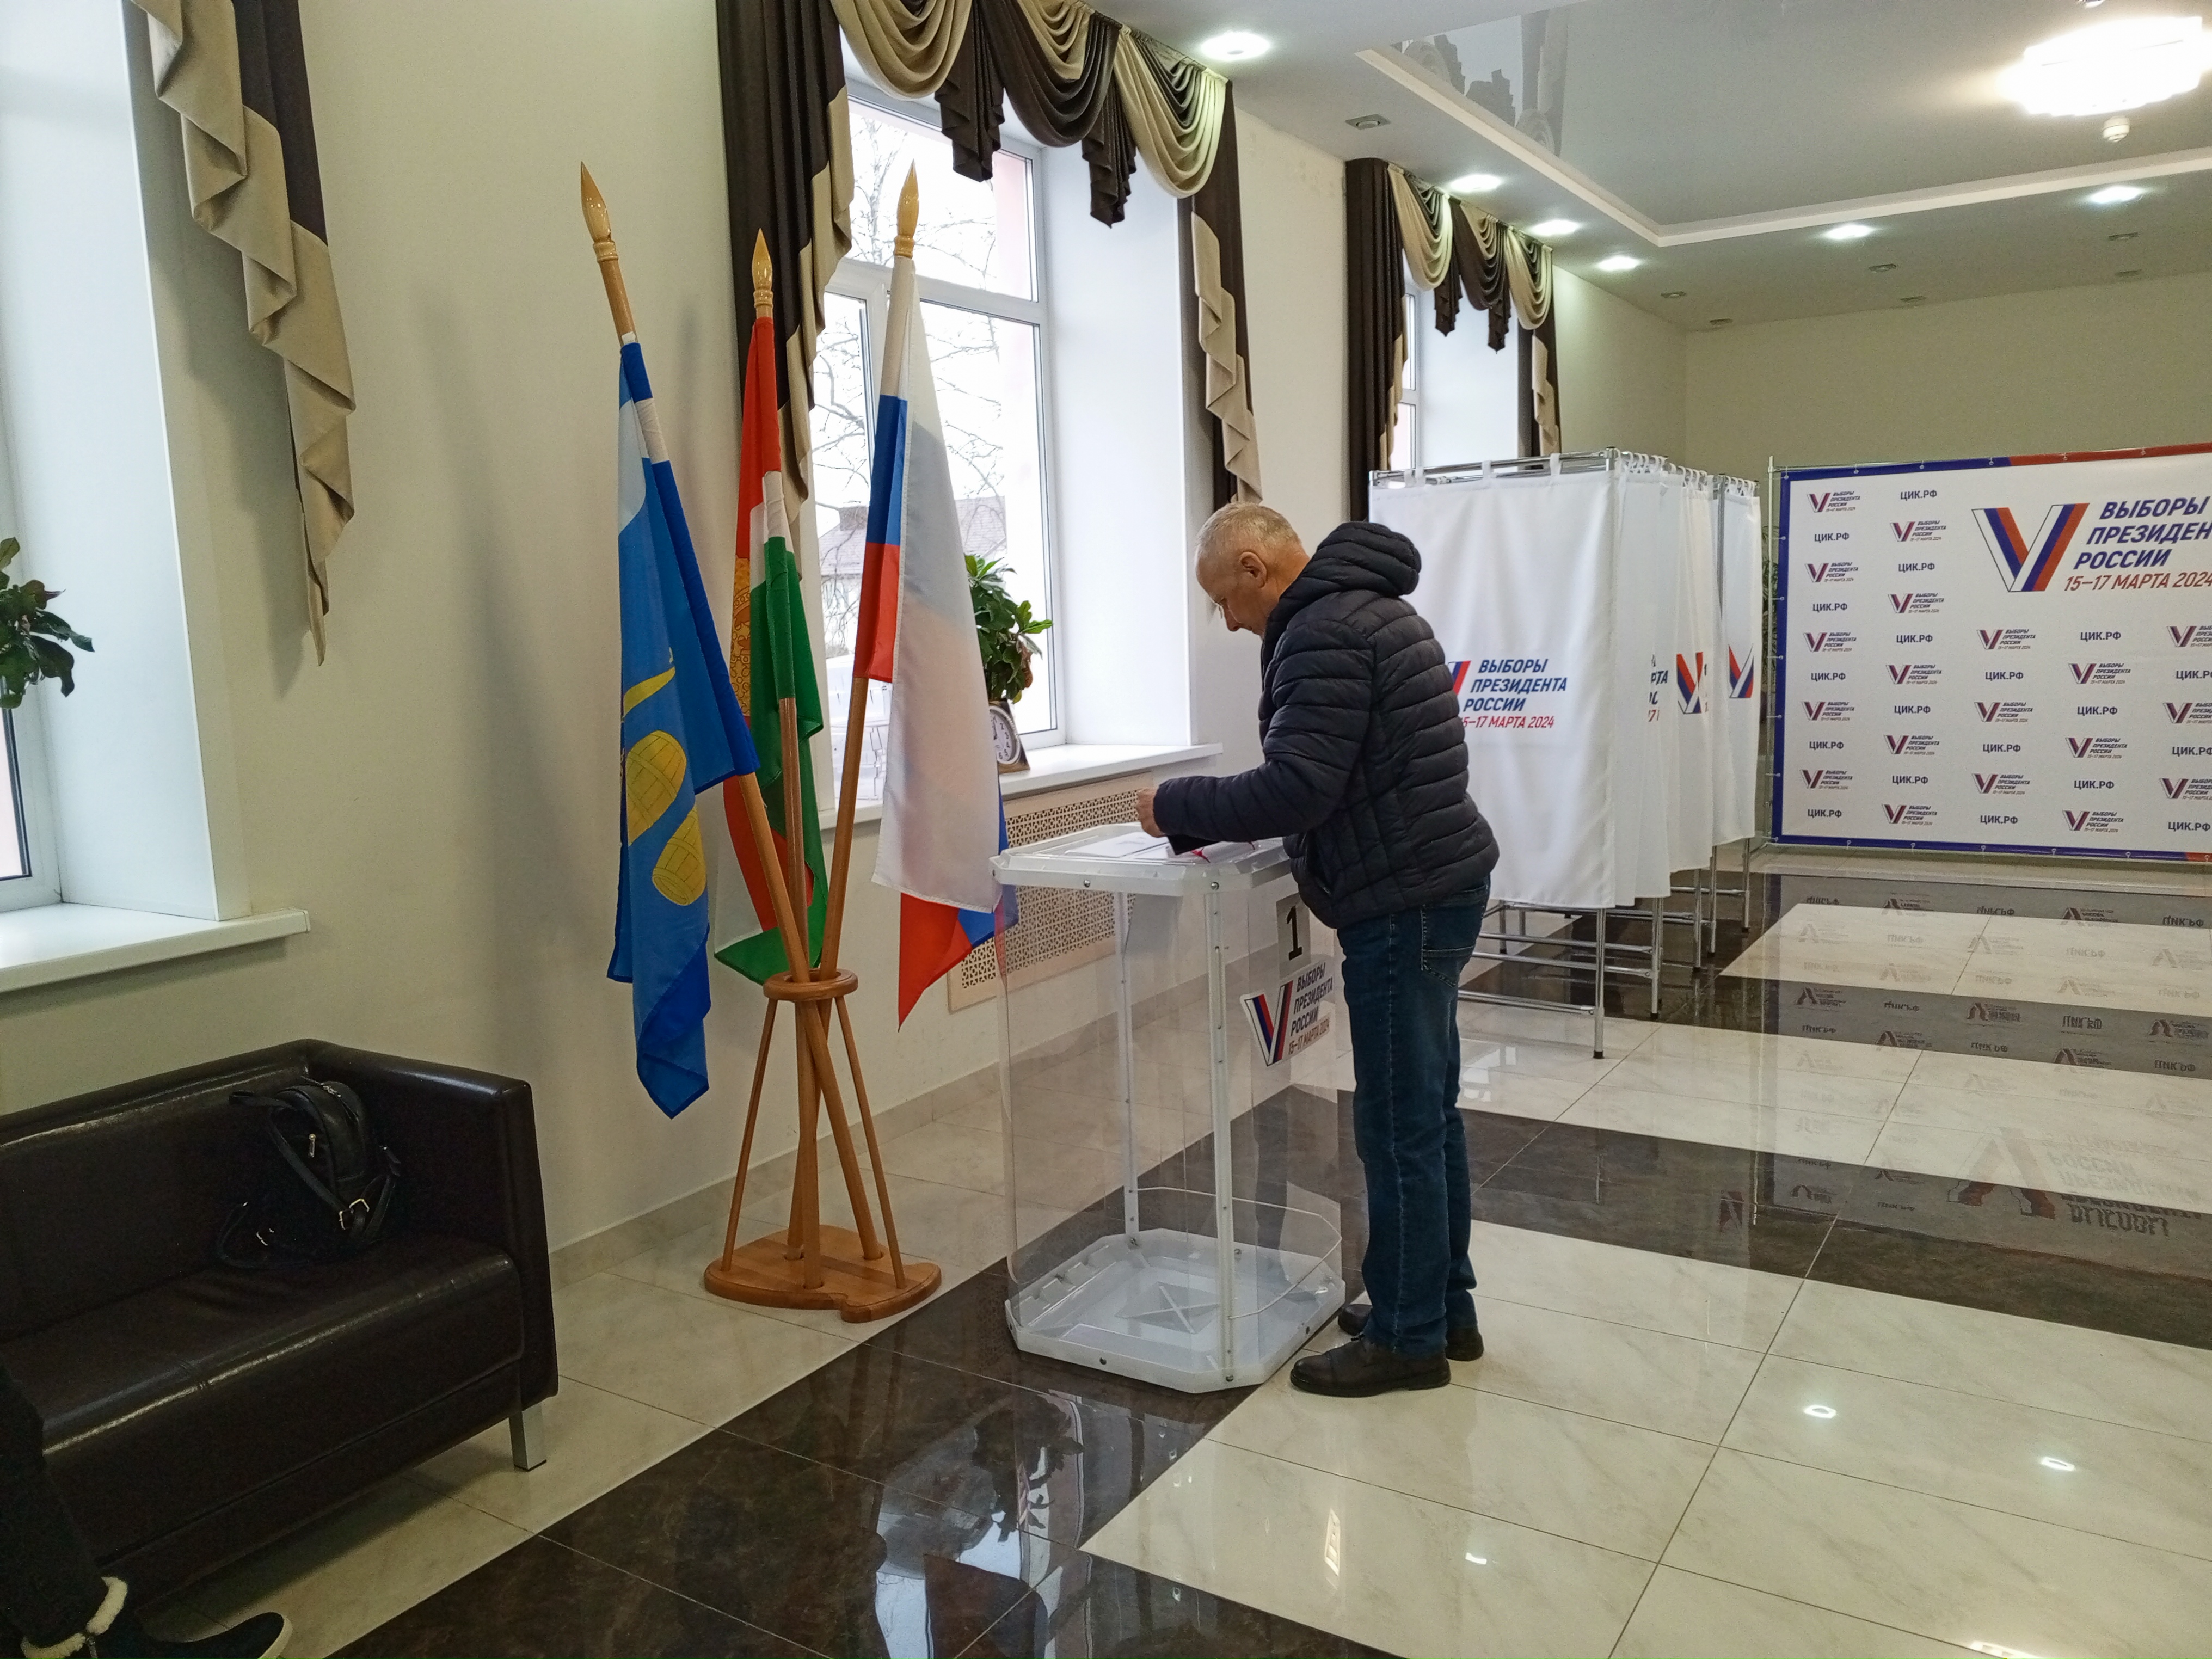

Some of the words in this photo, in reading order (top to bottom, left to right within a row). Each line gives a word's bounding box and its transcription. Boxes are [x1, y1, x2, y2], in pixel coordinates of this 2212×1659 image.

[1901, 490, 1937, 501] ЦИК.РФ
[2099, 496, 2210, 520] ВЫБОРЫ
[1815, 532, 1849, 543] ЦИК.РФ
[2073, 549, 2173, 570] РОССИИ
[1898, 563, 1935, 573] ЦИК.РФ
[2111, 573, 2172, 590] МАРТА
[2172, 572, 2212, 588] 2024
[1812, 603, 1847, 612] ЦИК.РФ
[1896, 635, 1933, 644] ЦИК.РФ
[2080, 631, 2121, 642] ЦИК.РФ
[1478, 659, 1548, 673] ВЫБОРЫ
[1811, 673, 1846, 681] ЦИК.РФ
[1985, 672, 2024, 681] ЦИК.РФ
[1470, 677, 1568, 694] ПРЕЗИДЕНТА
[1463, 697, 1526, 712] РОССИИ
[1894, 706, 1931, 715] ЦИК.РФ
[2077, 706, 2117, 716] ЦИК.РФ
[1461, 716, 1489, 728] 5–17
[1488, 716, 1525, 728] МАРТА
[1528, 716, 1554, 728] 2024
[1810, 742, 1844, 750] ЦИК.РФ
[1983, 744, 2021, 753] ЦИК.РФ
[2172, 747, 2212, 757] ЦИК.РФ
[1892, 776, 1928, 785] ЦИК.РФ
[2074, 781, 2114, 790] ЦИК.РФ
[1808, 809, 1842, 818] ЦИК.РФ
[1981, 815, 2018, 825] ЦИК.РФ
[2168, 822, 2210, 832] ЦИК.РФ
[1287, 906, 1302, 961] 1
[1297, 962, 1325, 992] ВЫБОРЫ
[1293, 977, 1332, 1015] ПРЕЗИДЕНТА
[1291, 1006, 1319, 1036] РОССИИ
